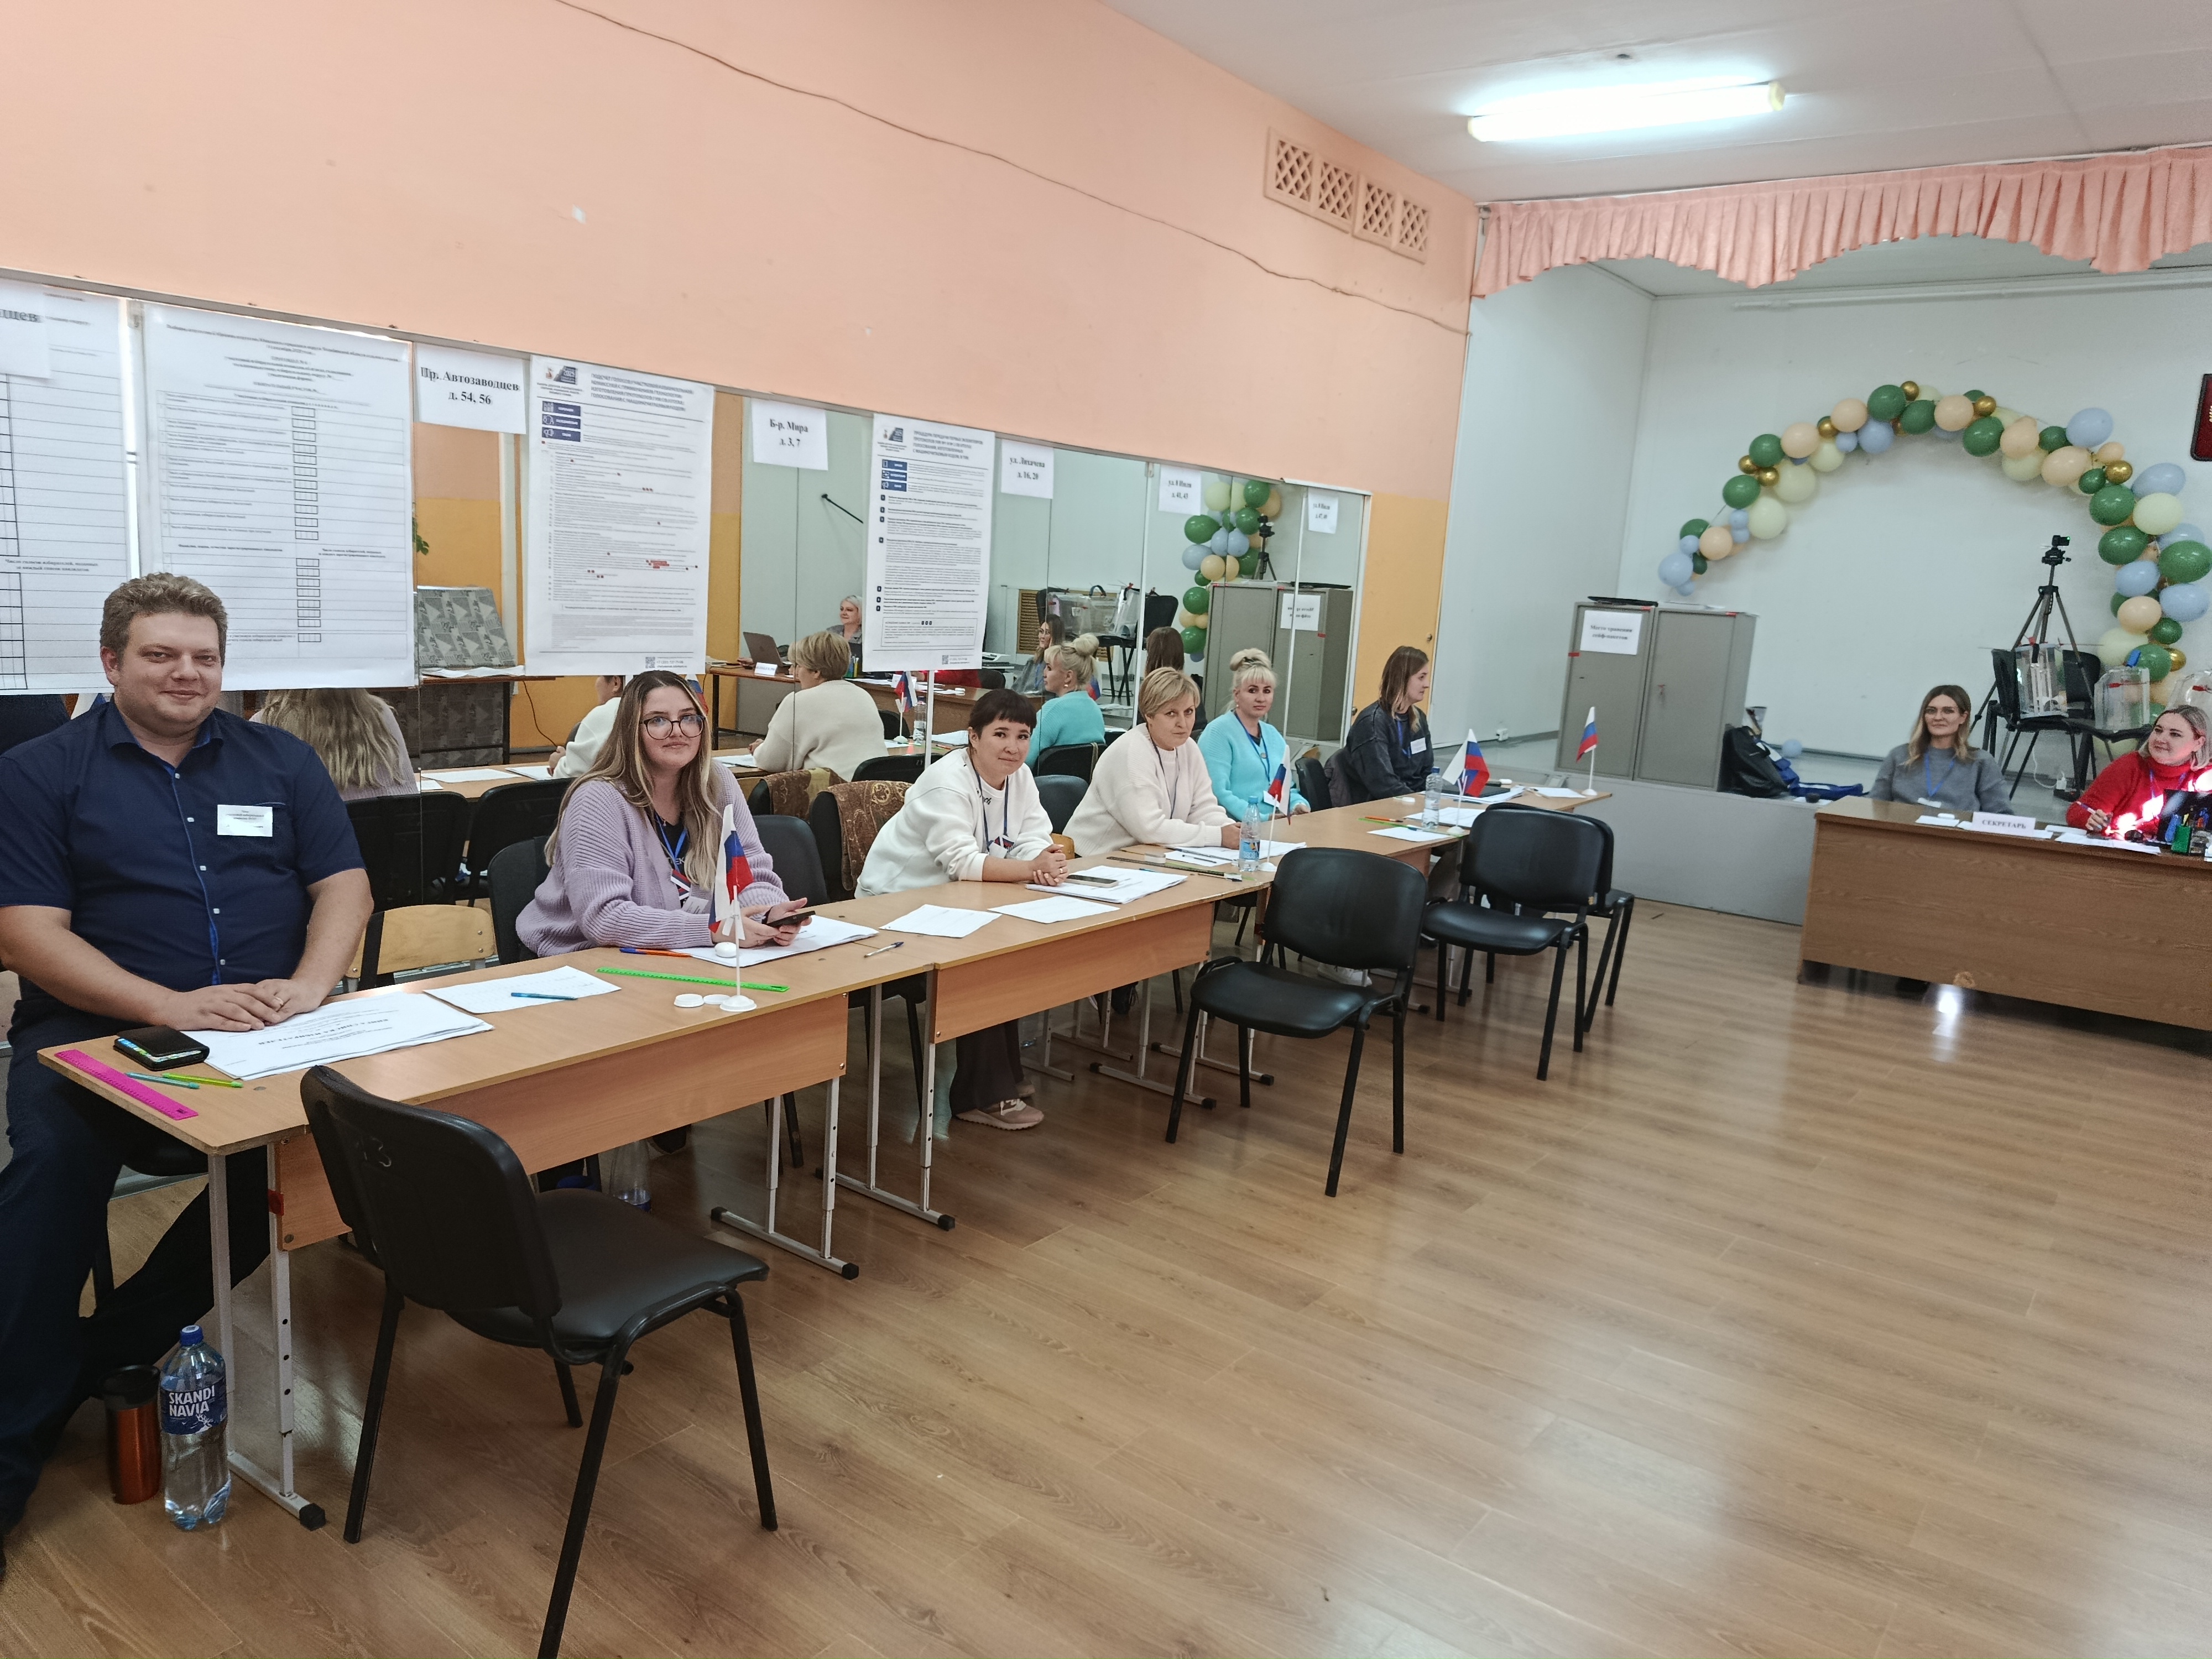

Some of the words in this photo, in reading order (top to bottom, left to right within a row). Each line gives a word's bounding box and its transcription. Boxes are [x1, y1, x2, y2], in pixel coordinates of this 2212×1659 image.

[421, 367, 439, 382] Пр.
[443, 371, 519, 391] Автозаводцев
[448, 391, 458, 400] д.
[461, 391, 476, 404] 54,
[479, 394, 492, 405] 56
[770, 419, 785, 431] Б-р.
[787, 421, 808, 434] Мира
[787, 437, 795, 447] 3,
[796, 438, 800, 447] 7
[1982, 820, 2026, 829] СЕКРЕТАРЬ
[169, 1385, 215, 1405] SKANDI
[169, 1400, 210, 1417] NAVIA
